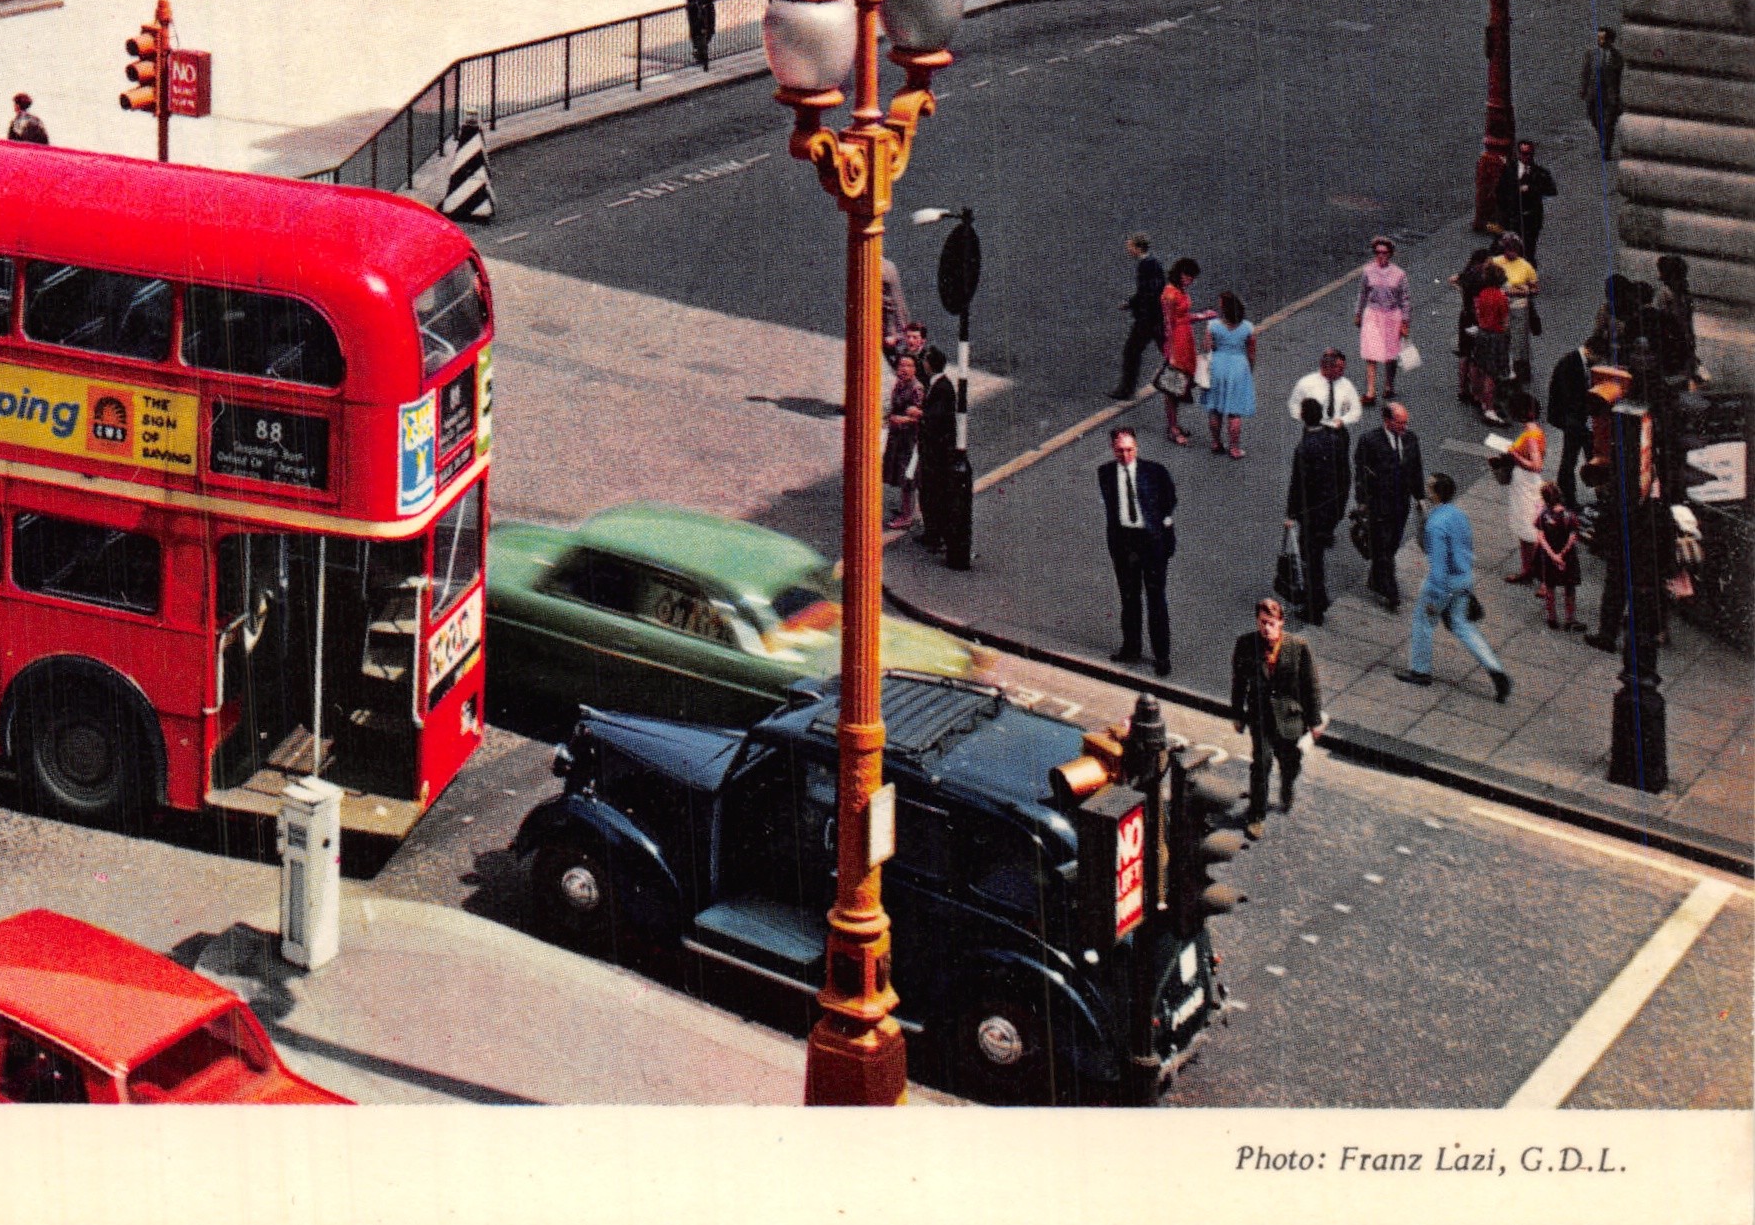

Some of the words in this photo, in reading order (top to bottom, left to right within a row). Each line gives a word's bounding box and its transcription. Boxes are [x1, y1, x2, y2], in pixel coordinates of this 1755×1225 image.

[172, 60, 197, 83] NO
[142, 396, 171, 412] THE
[256, 419, 282, 443] 88
